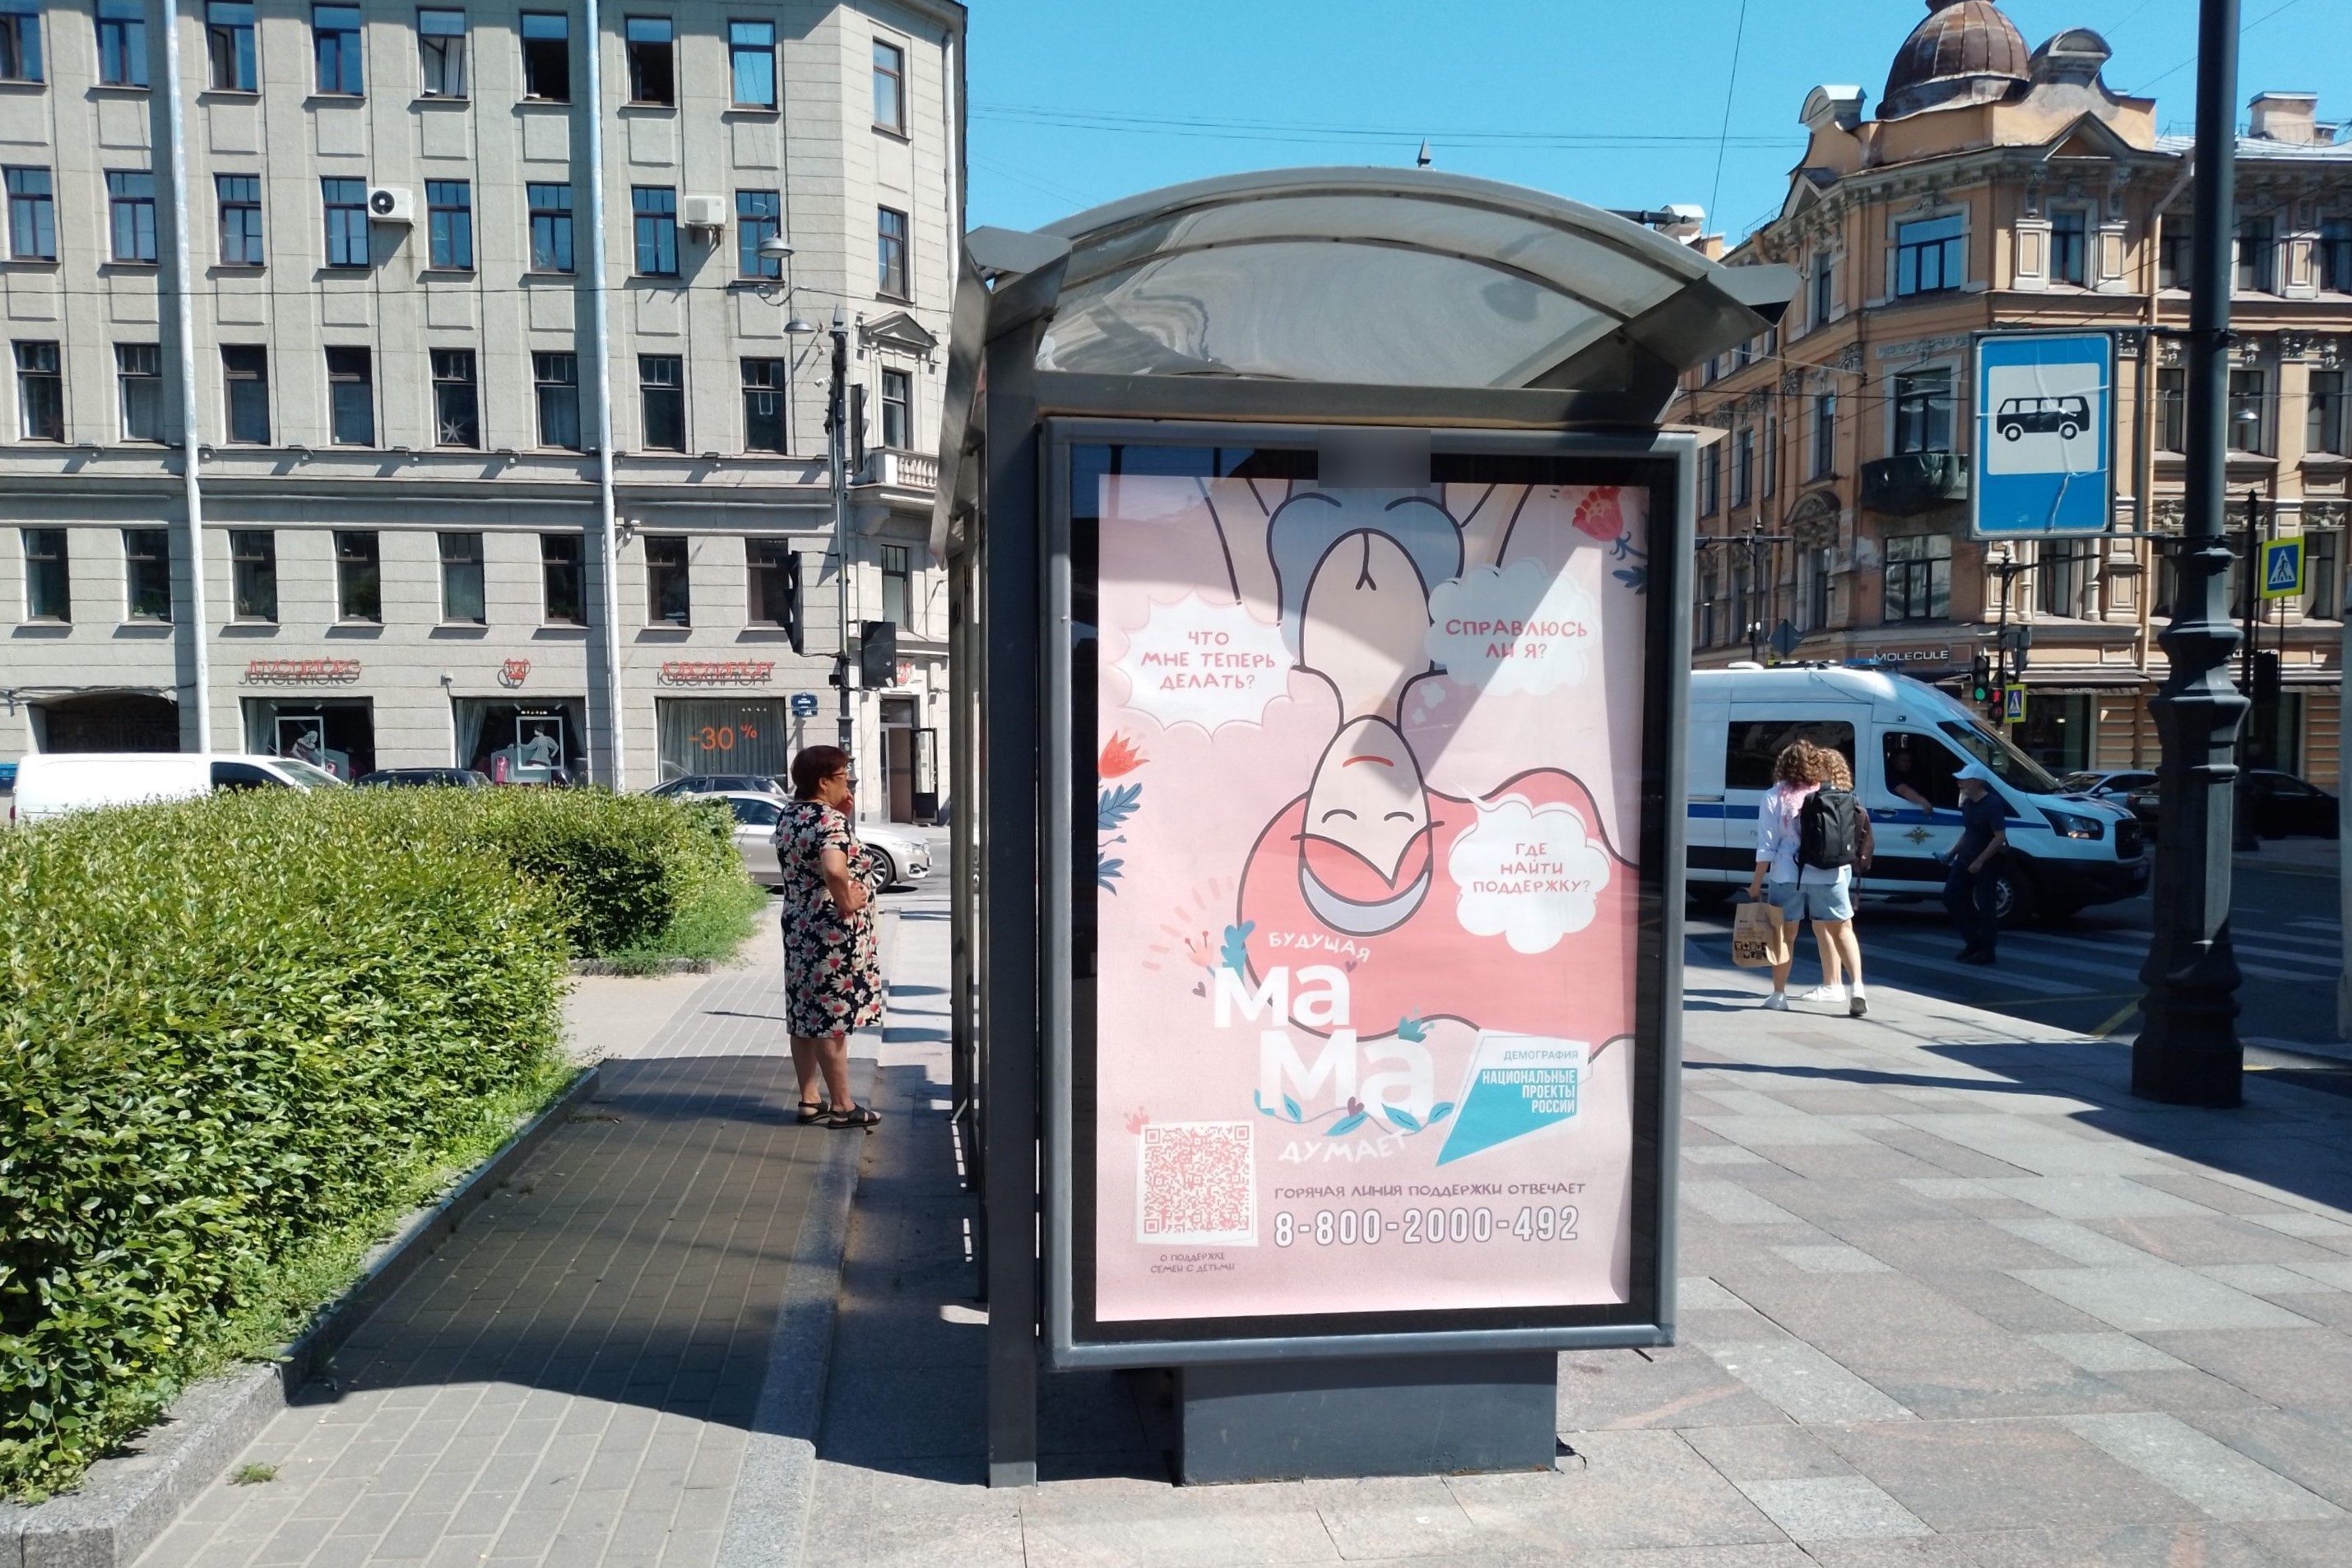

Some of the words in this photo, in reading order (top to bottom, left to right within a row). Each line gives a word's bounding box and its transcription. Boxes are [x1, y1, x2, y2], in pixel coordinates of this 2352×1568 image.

[1445, 619, 1588, 638] СПРАВЛЮСЬ
[1188, 631, 1229, 646] ЧТО
[1486, 643, 1515, 658] ЛИ
[1524, 643, 1547, 658] Я?
[1874, 650, 1949, 661] MOLECULE
[1141, 652, 1190, 667] МНЕ
[1201, 653, 1275, 668] ТЕПЕРЬ
[1160, 673, 1255, 690] ДЕЛАТЬ?
[1515, 842, 1547, 856] ГДЕ
[1501, 859, 1563, 874] НАЙТИ
[1473, 879, 1590, 894] ПОДДЕРЖКУ?
[1269, 931, 1371, 963] БУДУЩАЯ
[1504, 1051, 1578, 1061] ДЕМОГРАФИЯ
[1482, 1069, 1576, 1085] НАЦИОНАЛЬНЫЕ
[1522, 1085, 1576, 1098] ПРОЕКТЫ
[1531, 1099, 1575, 1113] РОССИИ
[1278, 1130, 1416, 1163] ДУМАЕТ
[1275, 1185, 1345, 1199] ГОРЯЧАЯ
[1352, 1185, 1402, 1197] ЛИНИЯ
[1408, 1183, 1502, 1197] ПОДДЕРЖКИ
[1508, 1182, 1585, 1194] ОТВЕЧАЕТ
[1274, 1205, 1579, 1247] 8-800-2000-492
[1160, 1254, 1167, 1262] О
[1171, 1252, 1226, 1262] ПОДДЕРЖКЕ
[1186, 1264, 1195, 1273] С
[1196, 1263, 1236, 1273] ДЕТЬМИ
